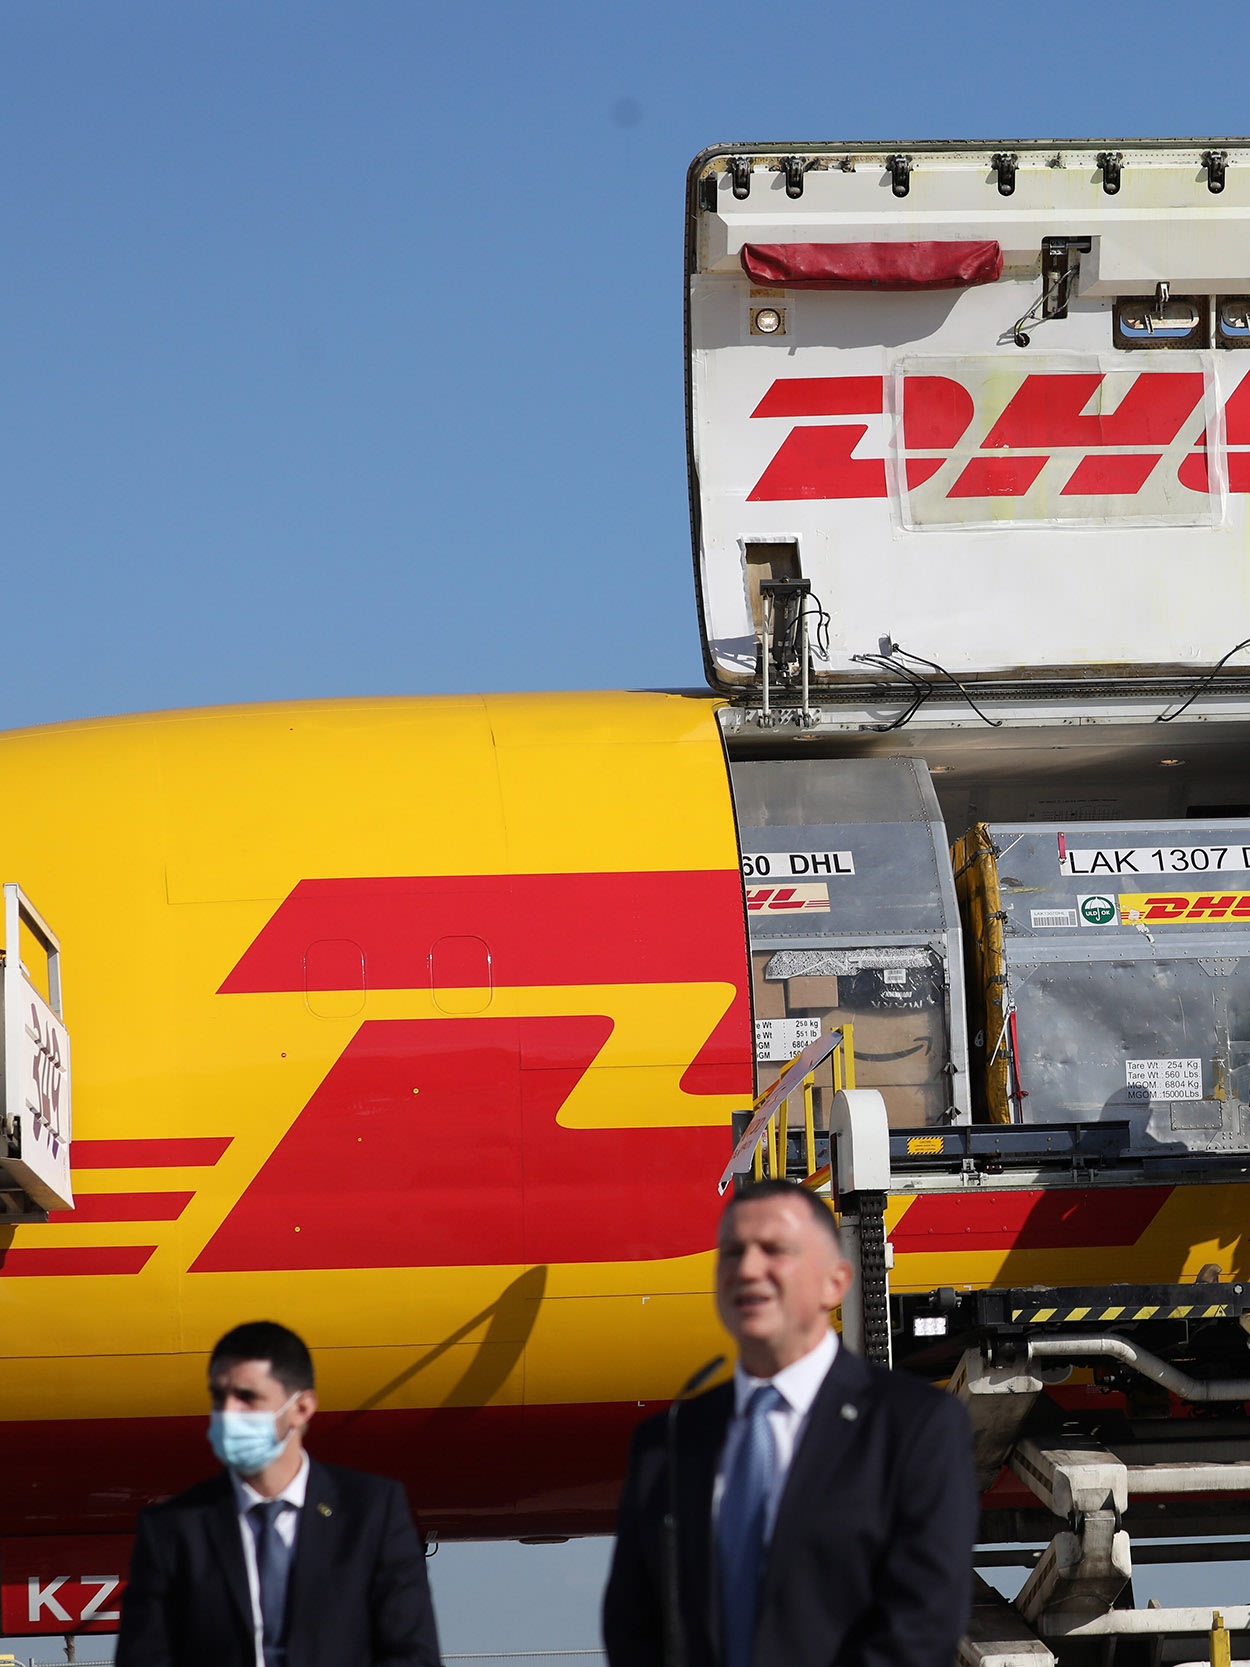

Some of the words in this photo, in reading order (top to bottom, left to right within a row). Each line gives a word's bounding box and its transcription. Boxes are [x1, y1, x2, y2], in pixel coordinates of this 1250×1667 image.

[789, 853, 852, 875] DHL
[1069, 850, 1139, 874] LAK
[1151, 847, 1229, 872] 1307
[762, 1021, 773, 1029] Wt
[810, 1020, 819, 1029] kg
[796, 1030, 808, 1038] 551
[757, 1042, 770, 1050] GM
[792, 1040, 809, 1049] 6804
[757, 1052, 770, 1060] GM
[1167, 1060, 1183, 1069] 254
[1165, 1070, 1180, 1079] 560
[1165, 1080, 1185, 1089] 6804
